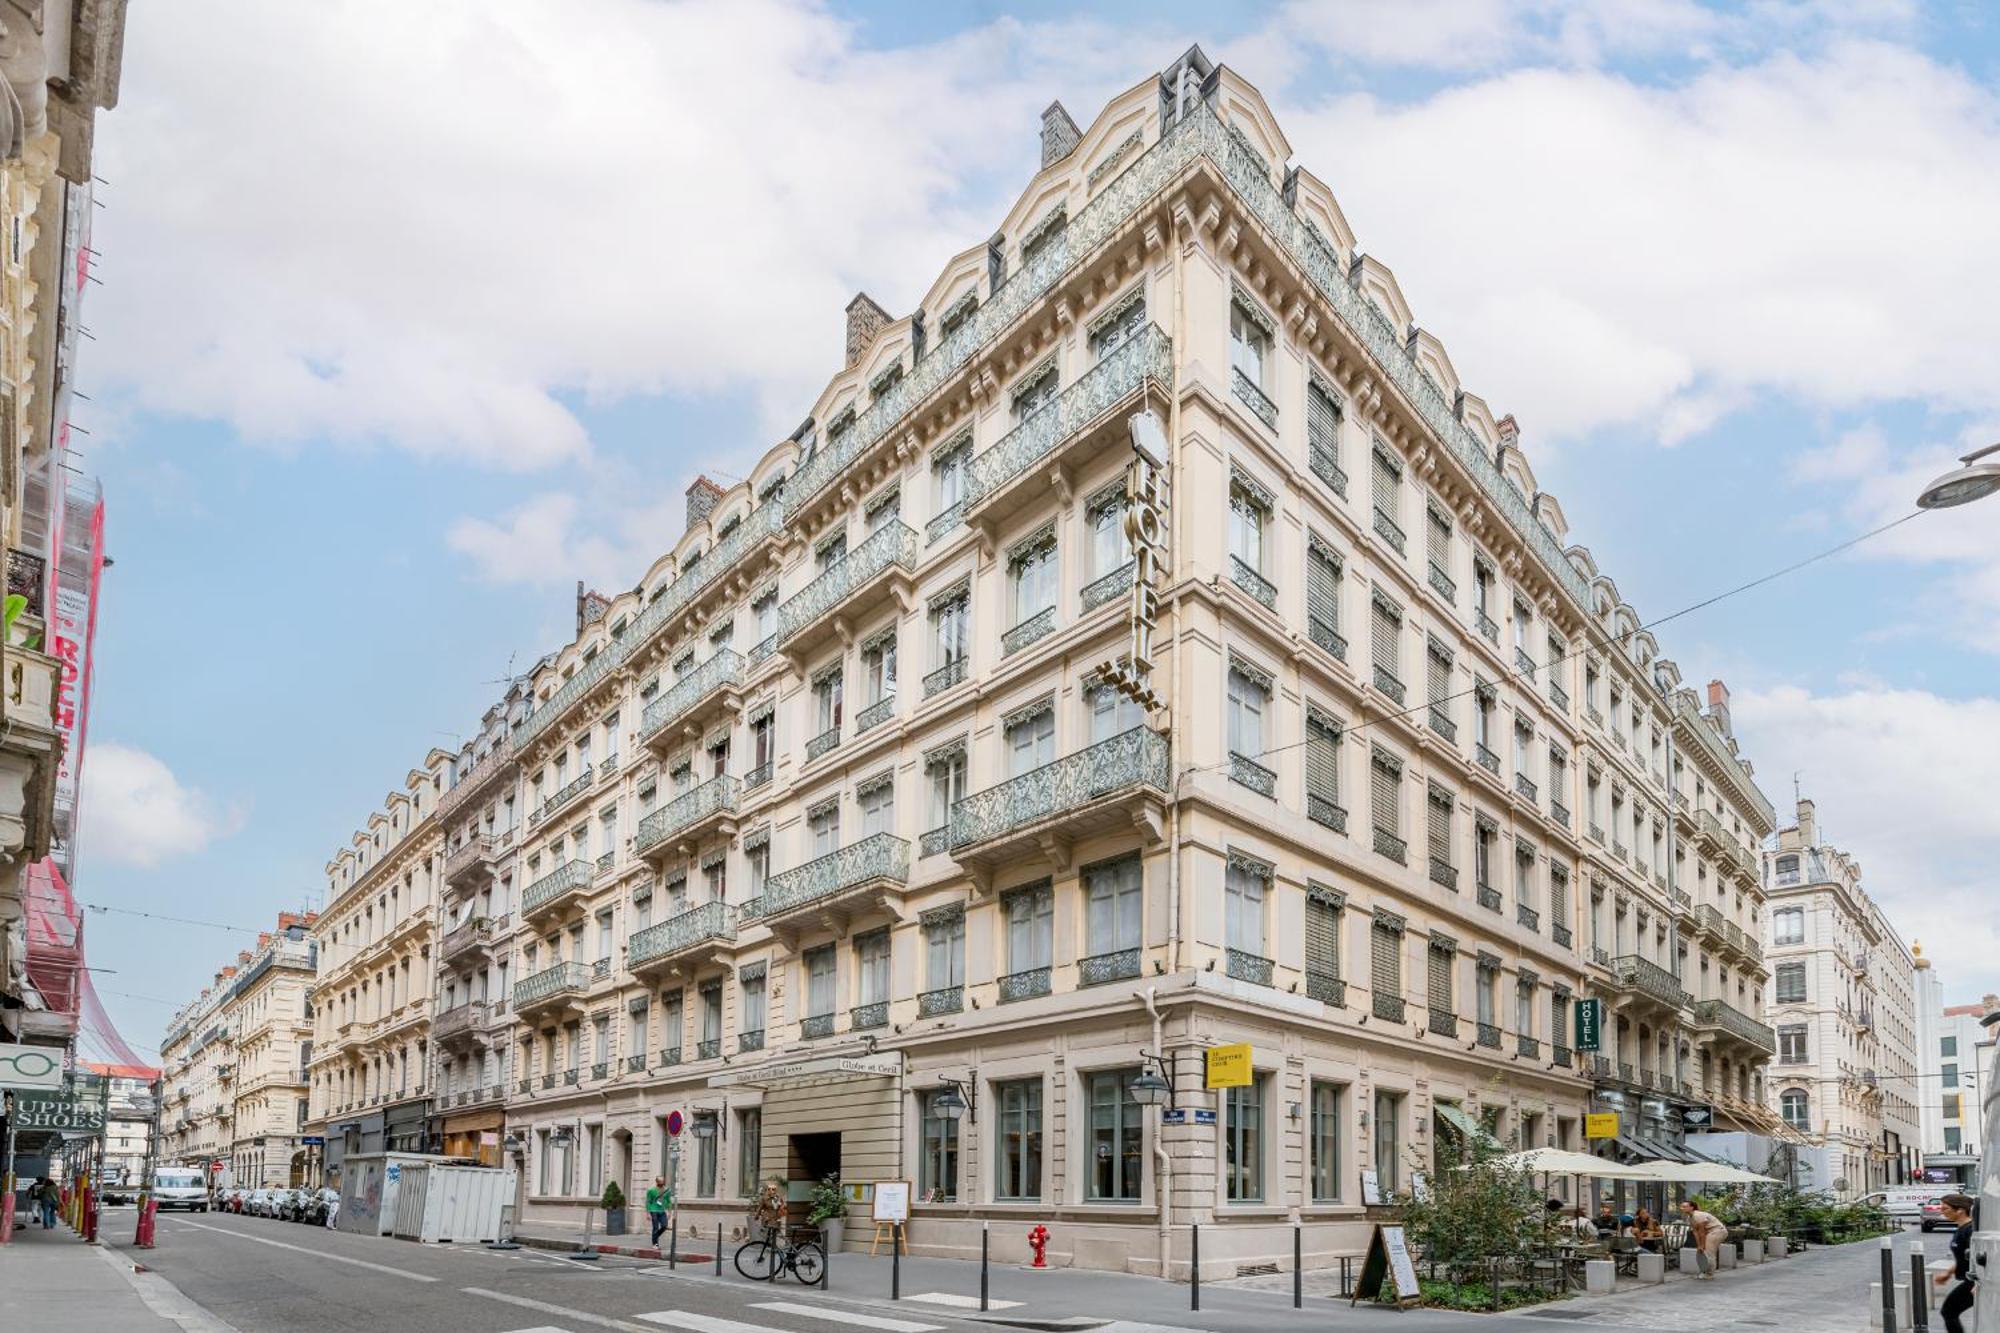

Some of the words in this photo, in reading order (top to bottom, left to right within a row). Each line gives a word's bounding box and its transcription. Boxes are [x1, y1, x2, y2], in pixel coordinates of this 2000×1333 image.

[1582, 1002, 1592, 1042] HOTEL
[17, 1100, 105, 1116] UPPER
[16, 1112, 103, 1128] SHOES
